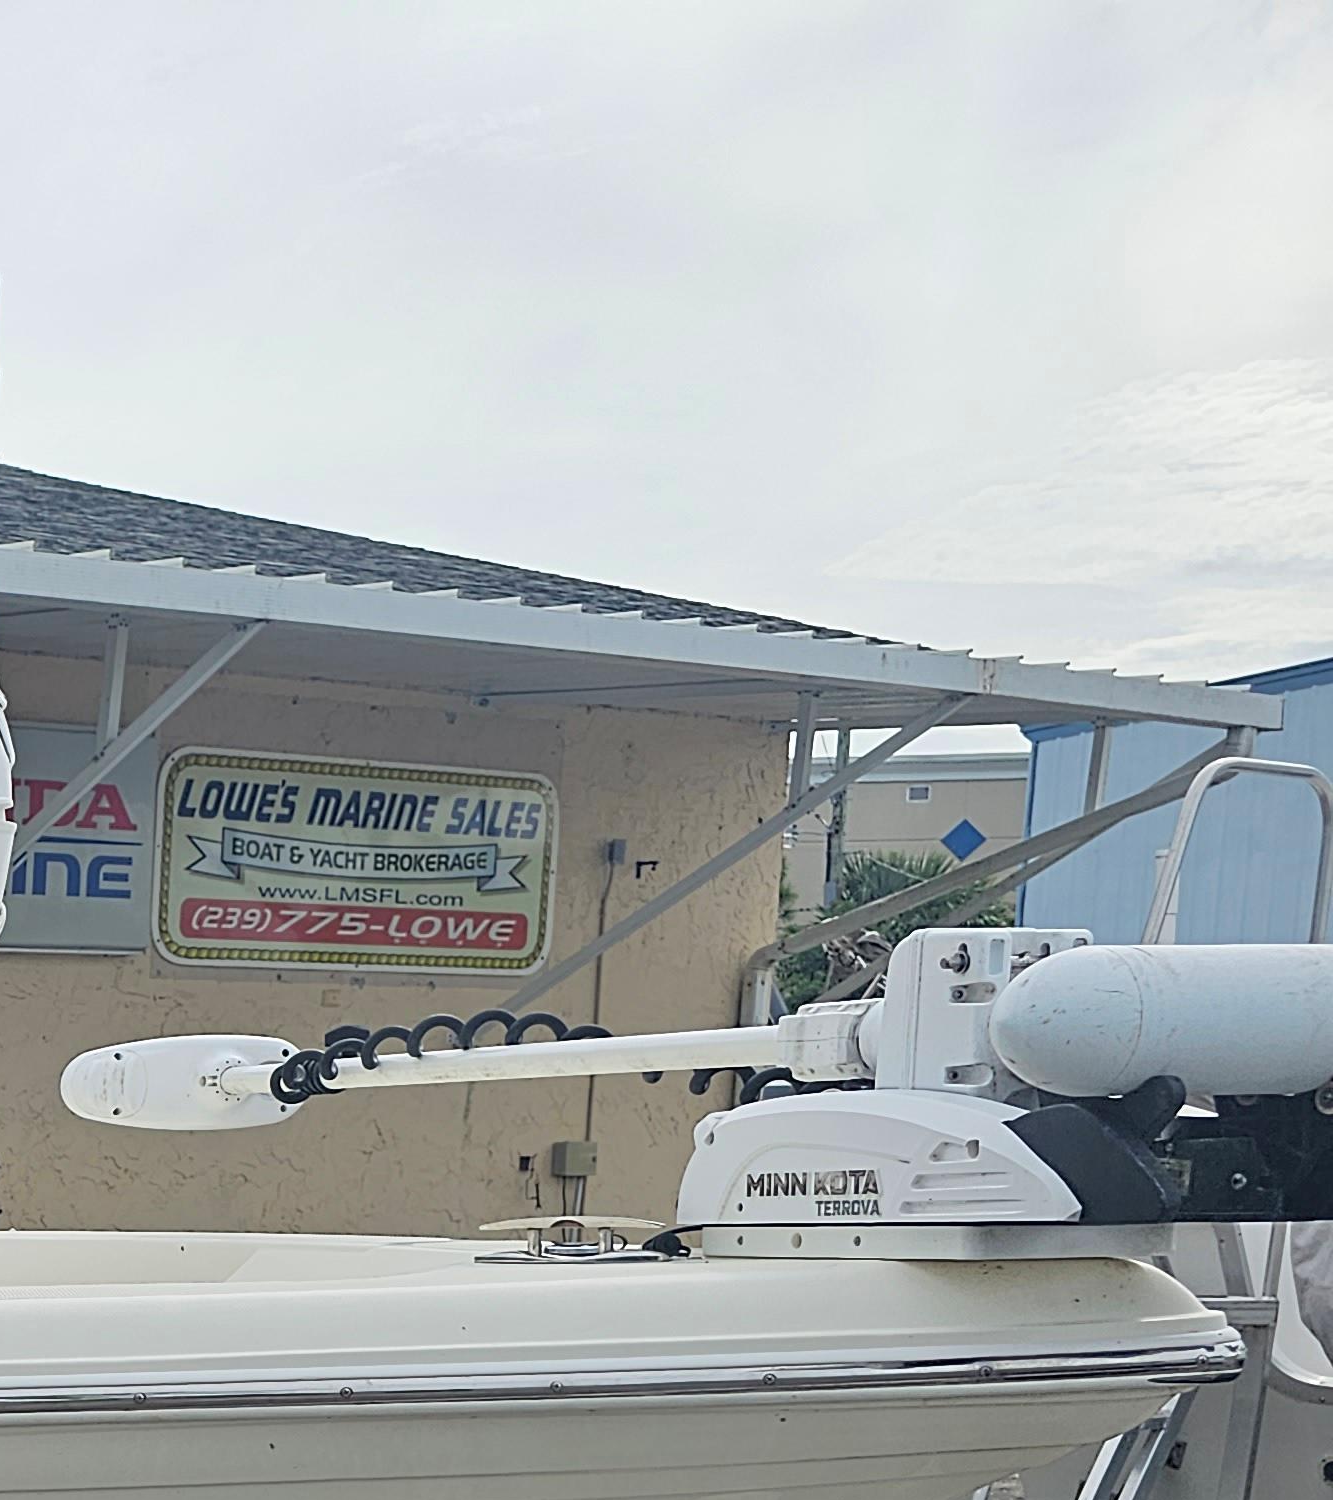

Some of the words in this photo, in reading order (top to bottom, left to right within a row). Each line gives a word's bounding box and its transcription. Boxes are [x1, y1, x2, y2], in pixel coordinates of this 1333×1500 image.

[177, 778, 299, 825] LOWE'S
[306, 786, 439, 834] MARINE
[444, 796, 543, 840] SALES
[232, 836, 286, 864] BOAT
[289, 844, 305, 864] &
[309, 848, 370, 872] YACHT
[373, 850, 489, 873] BROKERAGE
[258, 884, 464, 907] www.LMSFL.com
[191, 904, 272, 933] (239)
[273, 909, 518, 942] 775-LOWE
[746, 1172, 808, 1197] MINN
[813, 1169, 879, 1196] KOTA
[815, 1199, 881, 1217] TERROVA
